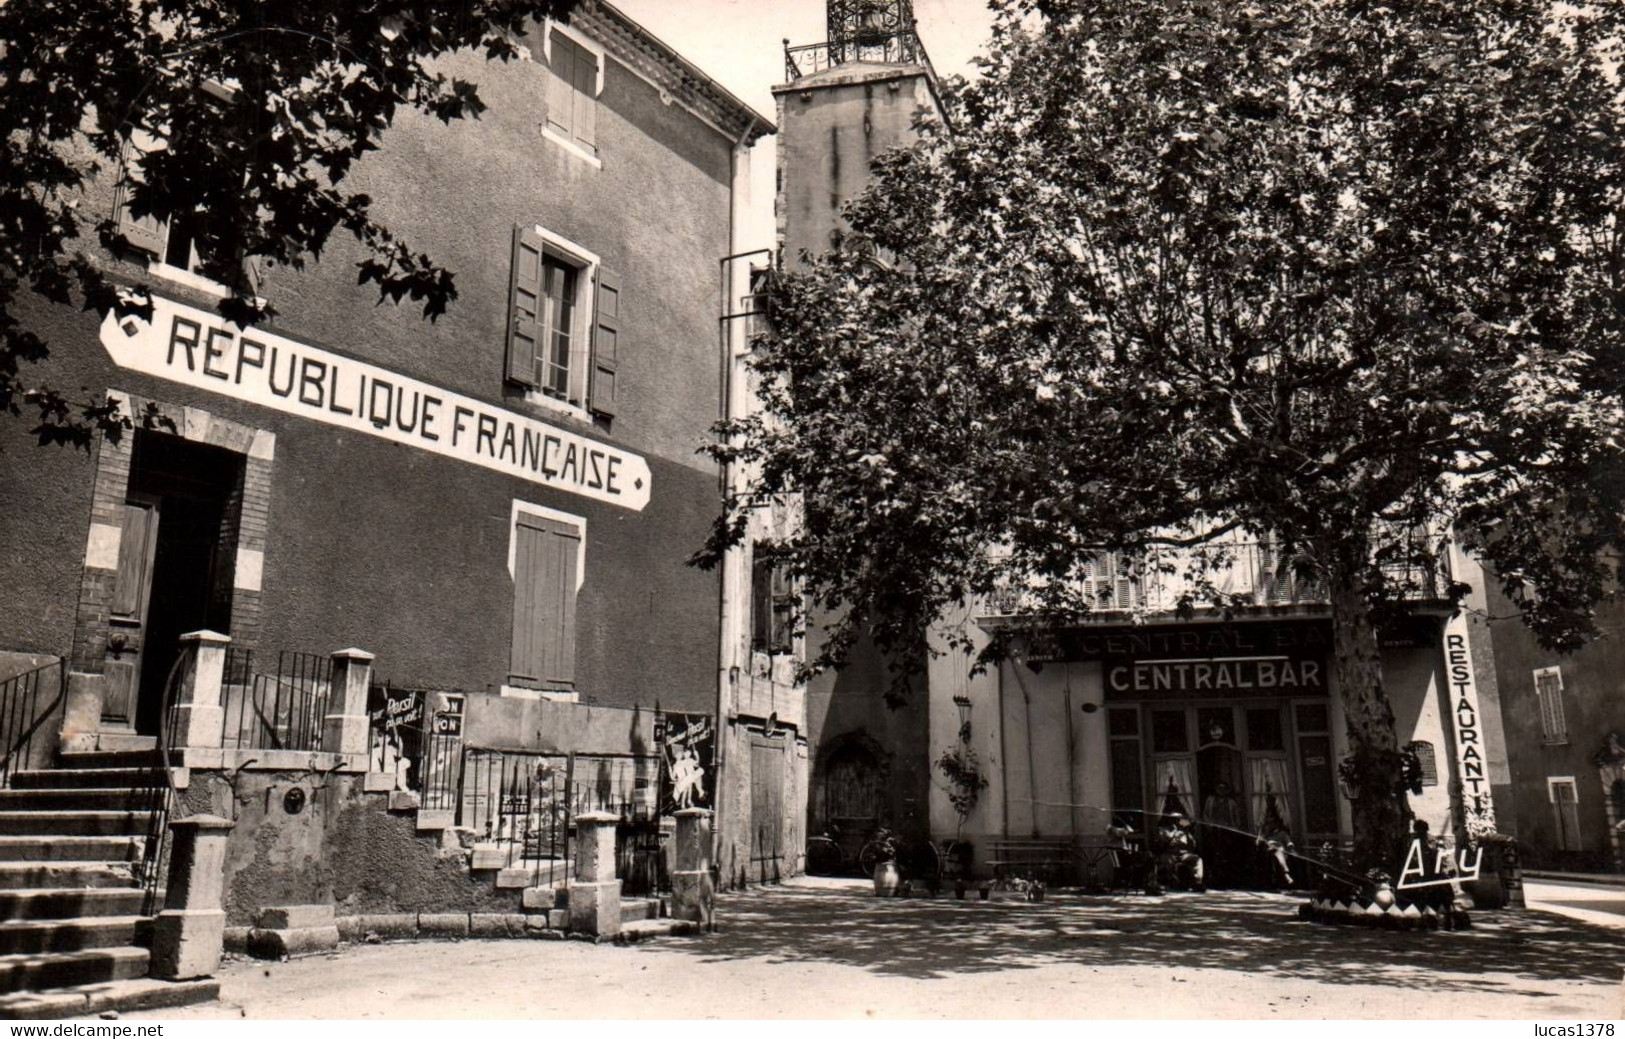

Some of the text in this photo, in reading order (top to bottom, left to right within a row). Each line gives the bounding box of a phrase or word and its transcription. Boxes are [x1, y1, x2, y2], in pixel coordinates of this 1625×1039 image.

[166, 314, 443, 441] REPUBLIQUE
[1082, 627, 1326, 654] CENTRAL BA
[1110, 660, 1321, 692] CENTRAL BAR
[387, 691, 416, 714] Persil
[1447, 634, 1484, 793] RESTAURANT
